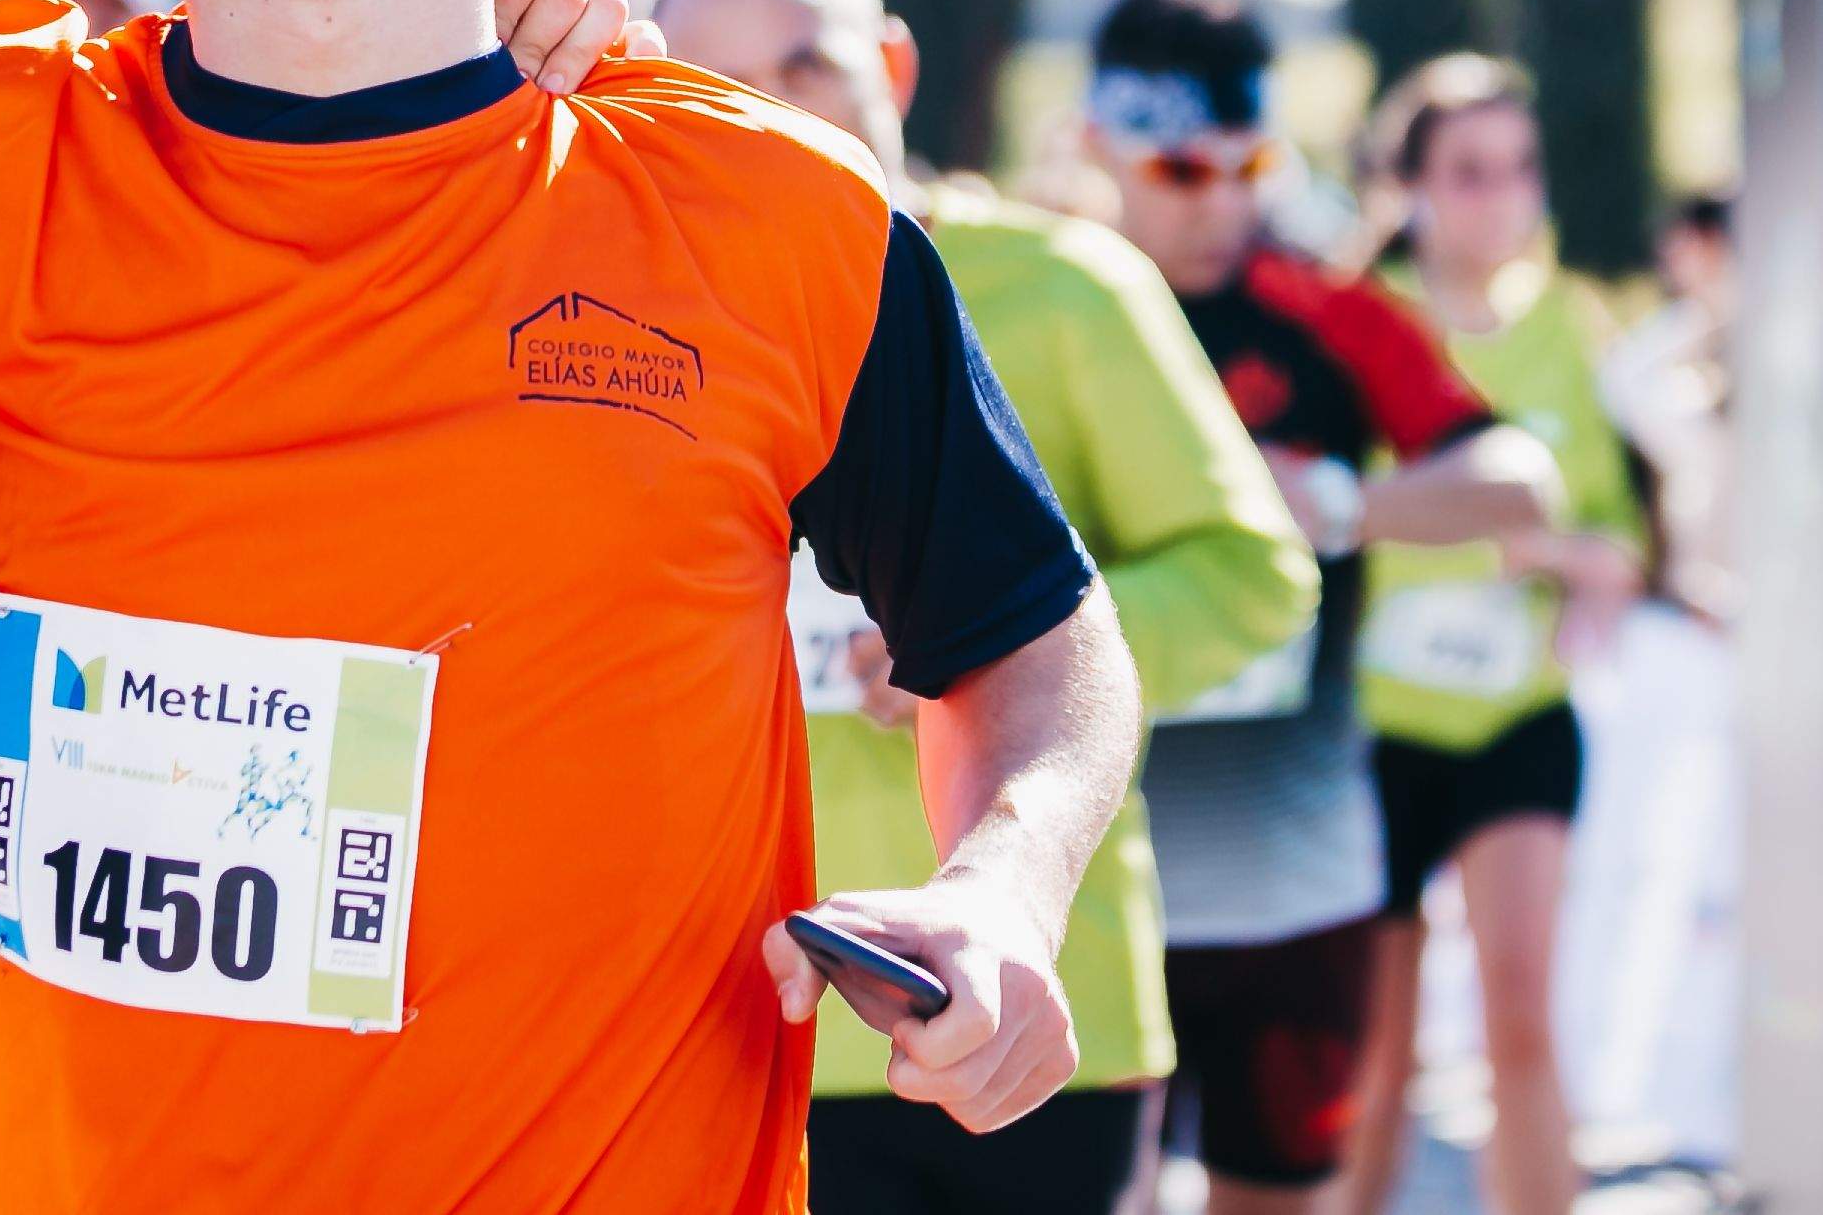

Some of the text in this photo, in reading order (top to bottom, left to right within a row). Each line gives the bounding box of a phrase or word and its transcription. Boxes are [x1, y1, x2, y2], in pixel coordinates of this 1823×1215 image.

[527, 339, 687, 372] COLEGIO MAYOR
[527, 356, 688, 403] ELÍAS AHÚJA
[120, 670, 311, 733] MetLife
[43, 839, 279, 983] 1450
